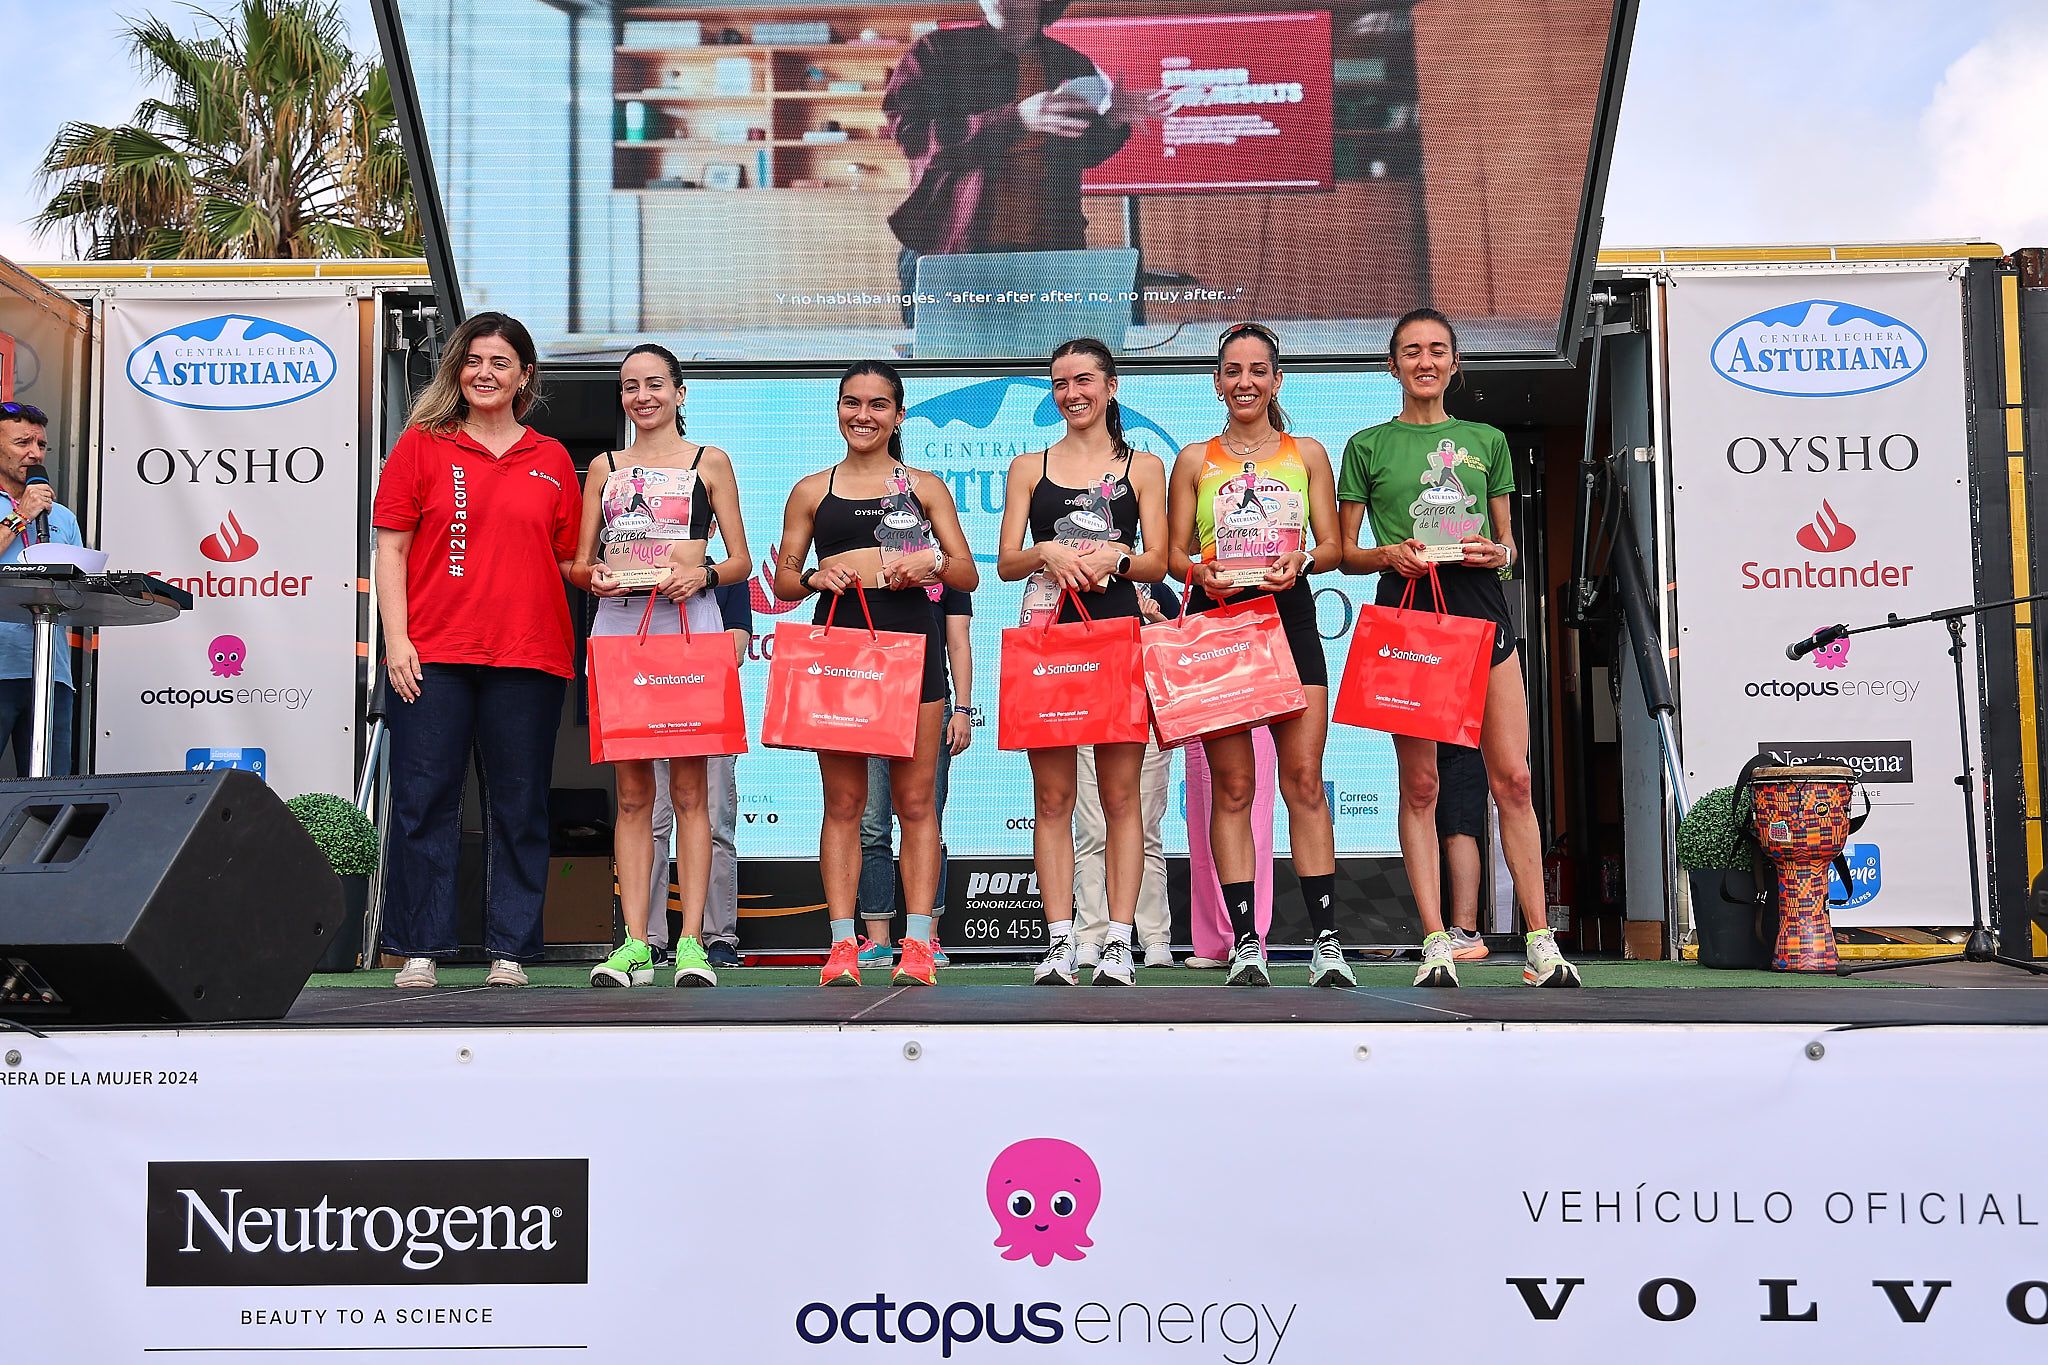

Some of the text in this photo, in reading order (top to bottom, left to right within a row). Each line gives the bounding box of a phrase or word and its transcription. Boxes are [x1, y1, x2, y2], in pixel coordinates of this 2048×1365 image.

[775, 293, 787, 305] Y
[791, 295, 812, 305] no
[816, 293, 882, 305] hablaba
[886, 293, 940, 307] inglés.
[996, 291, 1036, 303] after
[1040, 290, 1084, 304] after,
[1088, 292, 1113, 304] no,
[1118, 291, 1139, 301] no
[1143, 291, 1180, 303] muy
[1759, 332, 1903, 344] CENTRAL LECHERA
[175, 346, 315, 357] CENTRAL LECHERA
[1727, 336, 1912, 372] ASTURIANA
[141, 350, 322, 386] ASTURIANA
[924, 441, 1028, 458] CENTRAL
[1726, 433, 1919, 475] OYSHO
[137, 446, 325, 485] OYSHO
[451, 464, 467, 509] correr
[1227, 483, 1284, 494] Seano
[454, 510, 467, 520] a
[1413, 504, 1456, 517] Carrera
[877, 528, 915, 540] Carrera
[1058, 522, 1098, 541] Carrera
[1216, 527, 1259, 539] Carrera
[1419, 513, 1480, 540] de la Mujer
[604, 529, 647, 542] Carrera
[1058, 536, 1069, 546] de
[1070, 538, 1078, 548] la
[610, 541, 672, 564] de la Mujer
[1222, 536, 1284, 557] de la Mujer
[1741, 560, 1913, 589] Santander
[145, 570, 313, 598] antander
[1192, 641, 1250, 663] Santander
[1391, 648, 1442, 665] Santander
[823, 665, 884, 681] Santander
[1047, 661, 1100, 675] Santander
[648, 673, 705, 686] Santander
[140, 686, 313, 709] octopus energy
[1744, 679, 1920, 702] octopus energy
[1768, 750, 1903, 778] Negena
[1339, 791, 1378, 802] Correos
[1339, 804, 1379, 816] Express
[1006, 816, 1036, 830] octo
[965, 900, 1044, 909] SONORIZACIO
[1851, 892, 1872, 906] ALPES
[964, 919, 1043, 940] 696 455
[45, 1071, 67, 1086] DE
[70, 1071, 92, 1086] LA
[97, 1071, 153, 1086] MUJER
[158, 1070, 199, 1085] 2024
[1521, 1182, 2039, 1226] VEHÍCULO OFICIAL
[1505, 1277, 2048, 1325] VOLVO
[241, 1308, 494, 1326] BEAUTY TO A SCIENCE
[795, 1292, 1297, 1365] octopus energy
